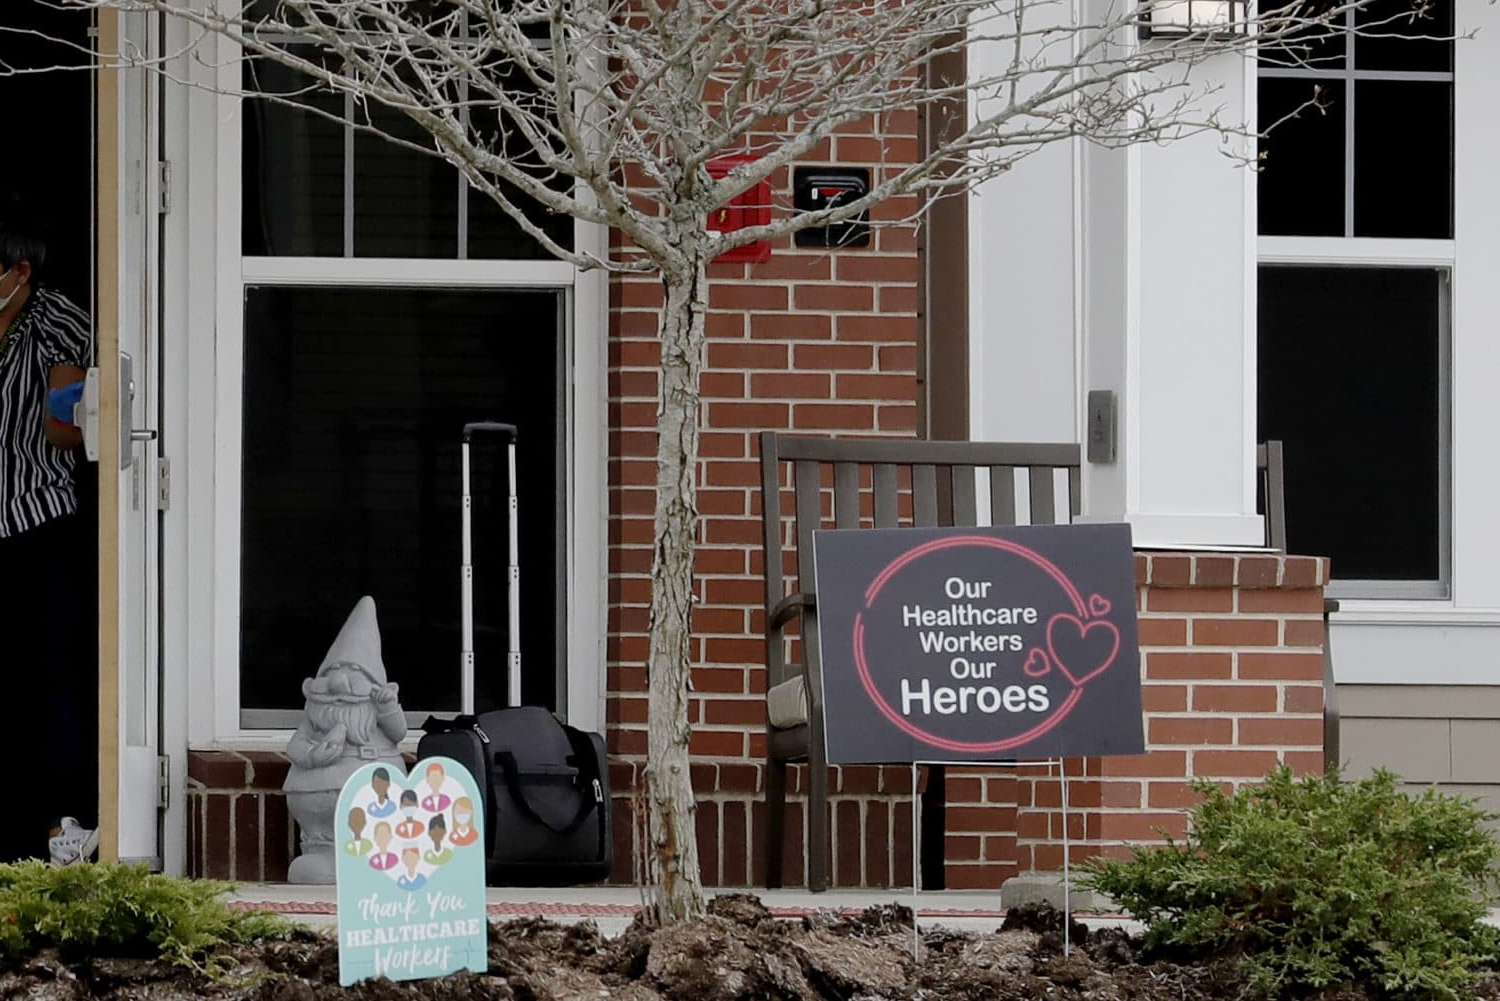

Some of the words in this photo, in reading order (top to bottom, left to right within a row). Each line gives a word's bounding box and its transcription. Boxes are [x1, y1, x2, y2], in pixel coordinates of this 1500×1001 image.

[944, 576, 992, 599] Our
[902, 603, 1038, 627] Healthcare
[919, 630, 1023, 654] Workers
[950, 657, 997, 680] Our
[900, 678, 1050, 716] Heroes
[357, 891, 419, 924] Thank
[426, 891, 467, 919] You
[346, 918, 481, 949] HEALTHCARE
[374, 943, 453, 977] Workers
